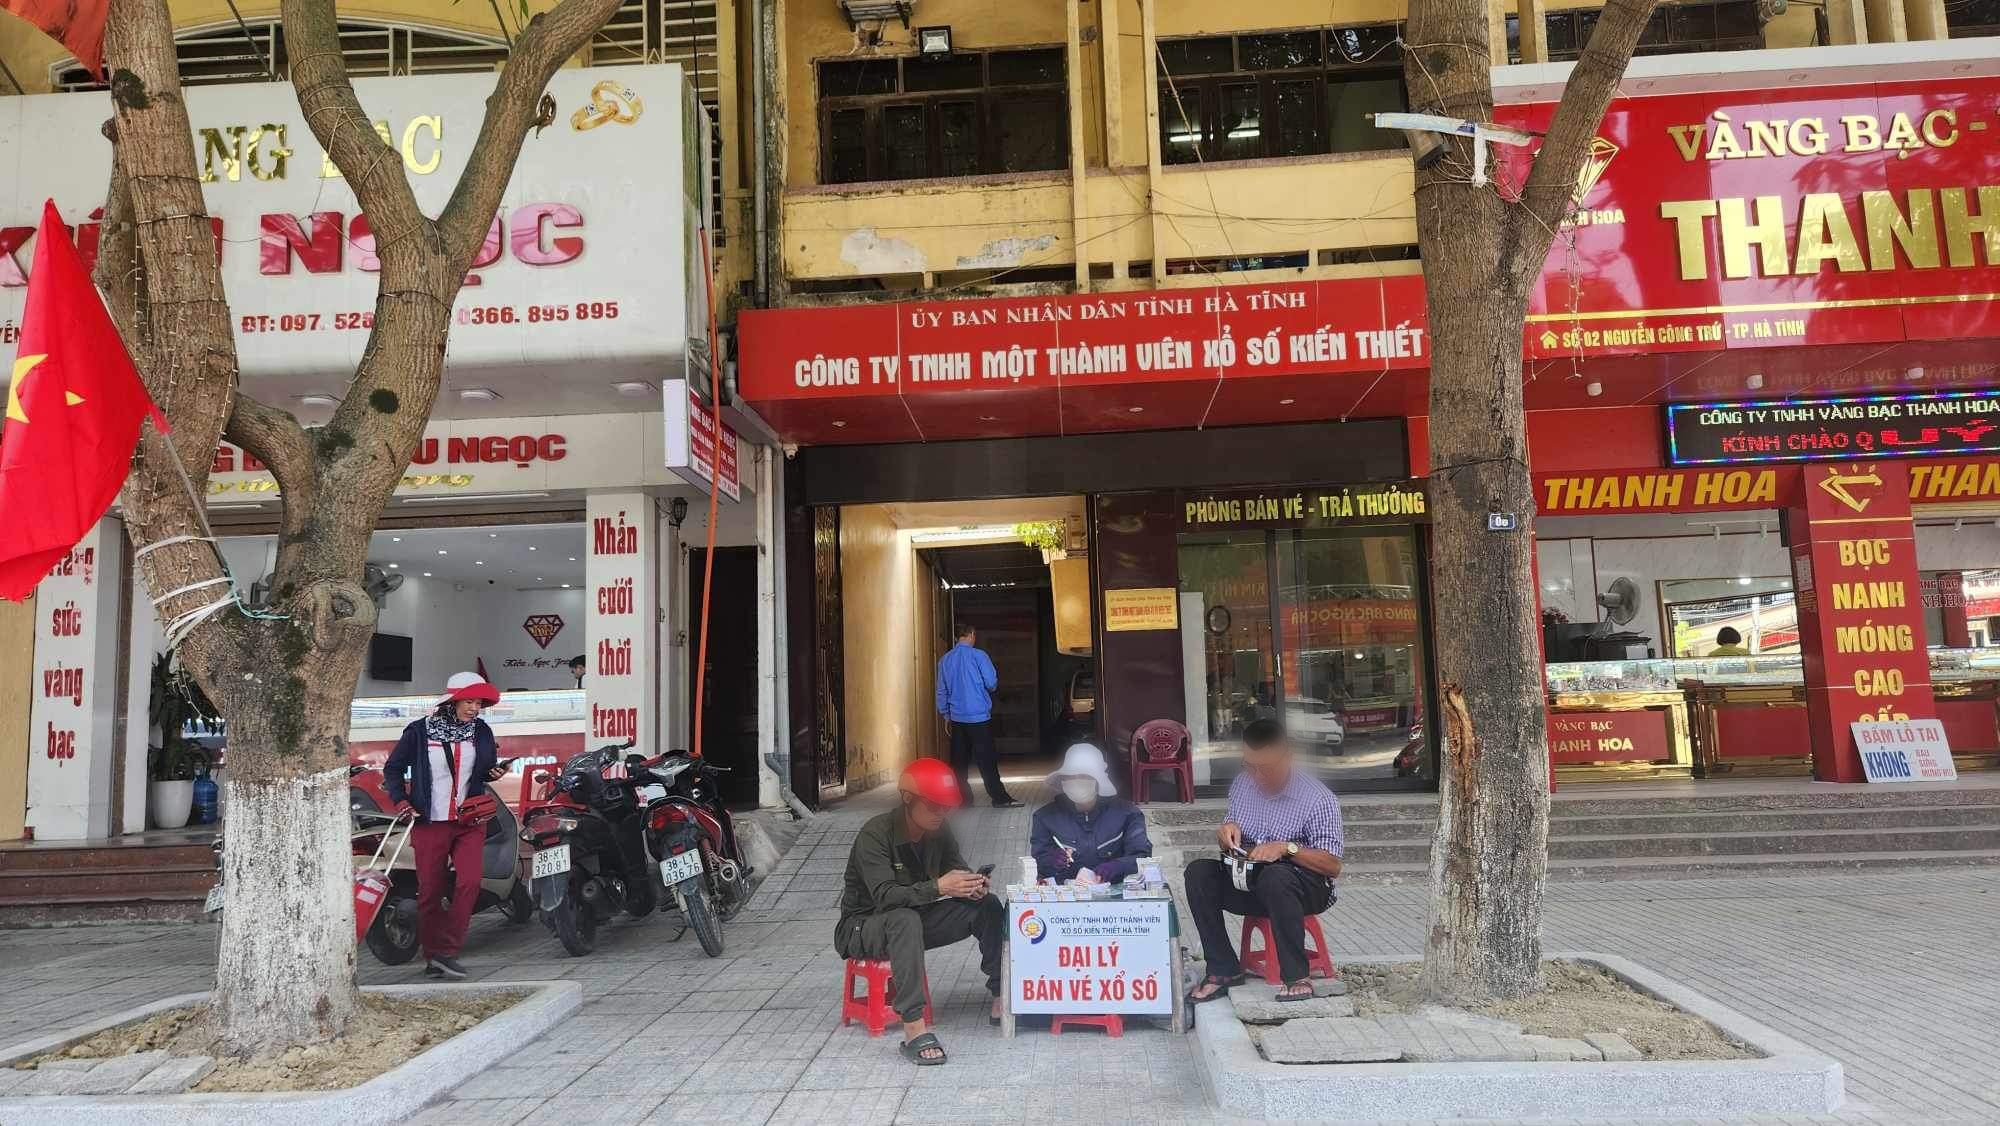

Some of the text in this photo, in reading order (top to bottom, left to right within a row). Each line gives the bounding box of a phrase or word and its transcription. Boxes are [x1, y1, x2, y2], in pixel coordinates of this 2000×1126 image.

[1667, 110, 1829, 161] VÀNG
[1841, 108, 1960, 160] BẠC
[1661, 185, 2000, 281] THANH
[528, 304, 570, 323] 895
[575, 301, 619, 320] 895
[952, 308, 997, 327] BAN
[1007, 301, 1073, 324] NHÂN
[1080, 300, 1127, 319] DÂN
[1205, 291, 1240, 313] HÀ
[1247, 290, 1308, 311] TĨNH
[1603, 322, 1655, 346] NGUYỄN
[1658, 323, 1693, 344] CÔNG
[795, 320, 1424, 387] CÔNG TY TNHH MỘT THÀNH VIÊN XỔ SỐ KIẾN THIẾT
[1700, 399, 2000, 426] CÔNG TY TNHH VÀNG BẠC THANH HOA
[447, 434, 567, 468] NGỌC
[1787, 426, 1849, 449] CHÀO
[1186, 496, 1241, 523] PHÒNG
[1245, 494, 1279, 521] BÁN
[1283, 493, 1304, 519] VÉ
[1319, 488, 1353, 518] TRẢ
[1356, 485, 1426, 517] THƯỞNG
[1544, 470, 1776, 510] THANH HOA
[1839, 539, 1890, 571] BỌC
[598, 577, 633, 615] cưới
[1832, 581, 1906, 610] NANH
[52, 601, 82, 637] sức
[1836, 619, 1914, 653] MÓNG
[598, 638, 632, 676] thời
[44, 661, 84, 708] vàng
[1854, 669, 1904, 697] CAO
[593, 702, 638, 746] trang
[1555, 719, 1614, 732] VÀNG BẠC
[1916, 727, 1940, 742] TAI
[47, 721, 76, 768] bạc
[1597, 737, 1634, 752] HOA
[1864, 745, 1911, 779] KHÔNG
[1058, 941, 1120, 973] ĐẠI LÝ
[1023, 970, 1158, 1001] BÁN VÉ XỔ SỐ
